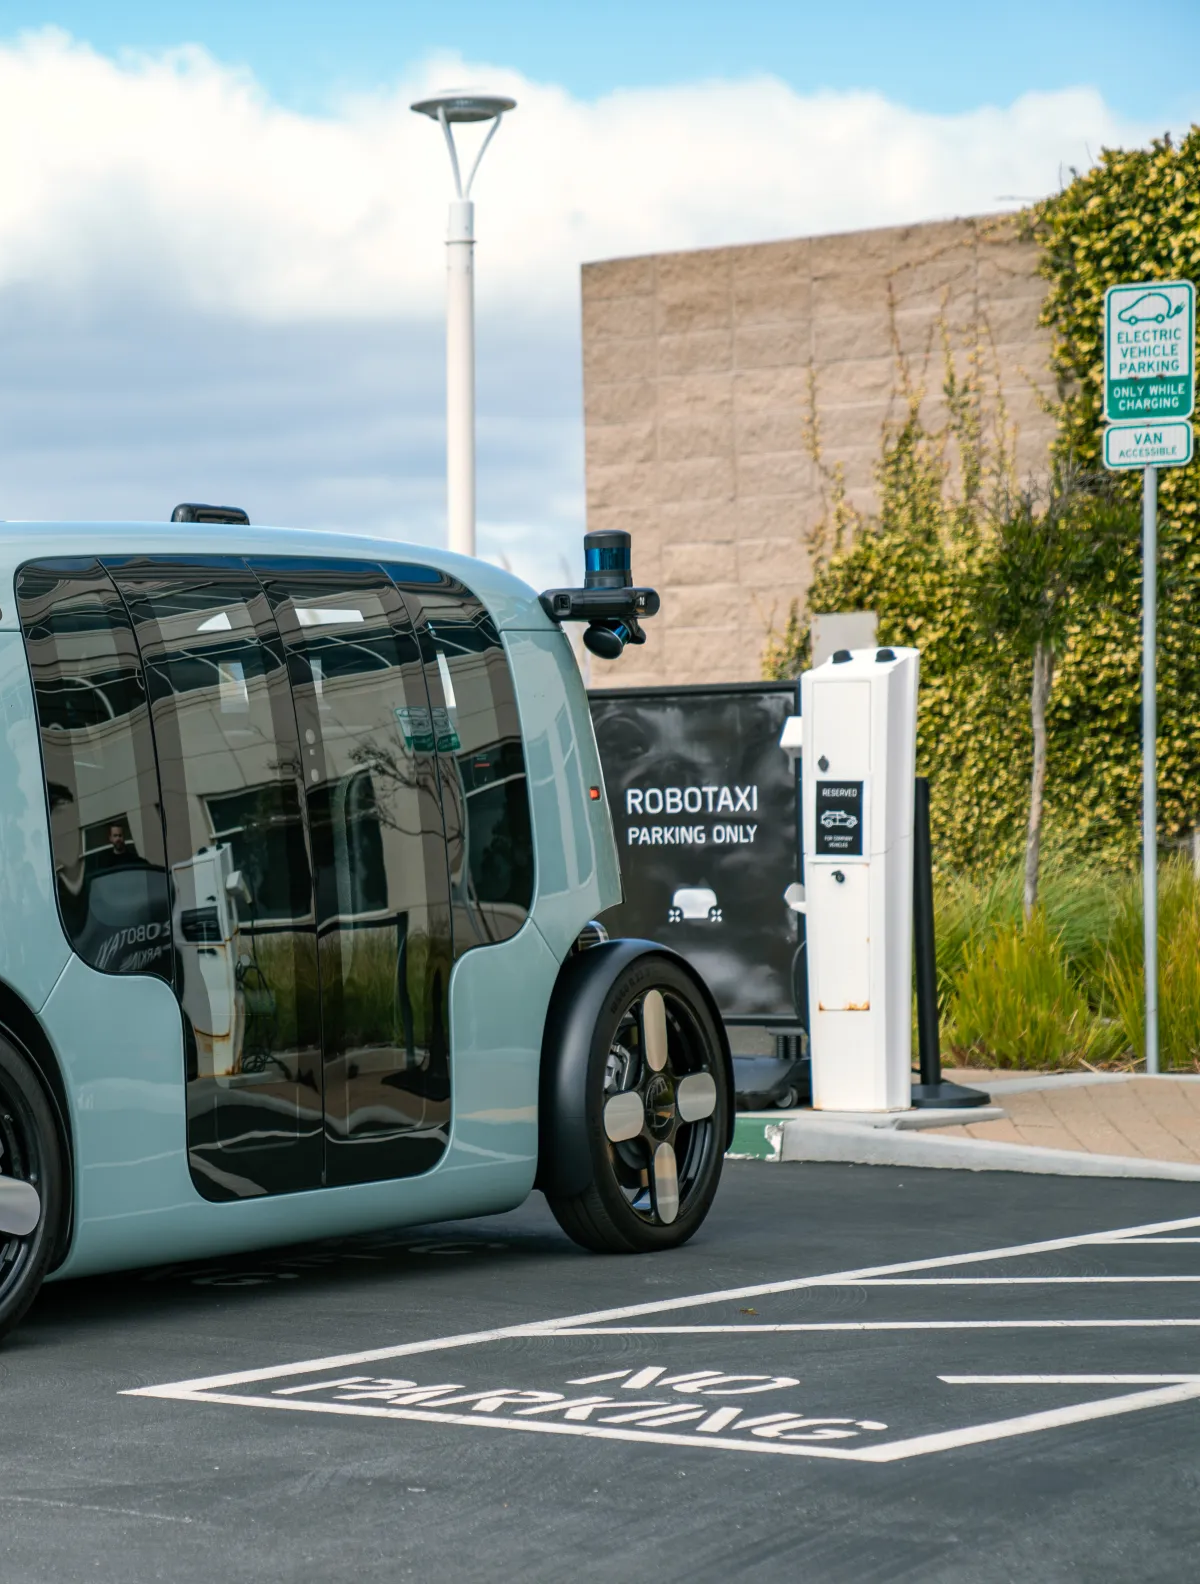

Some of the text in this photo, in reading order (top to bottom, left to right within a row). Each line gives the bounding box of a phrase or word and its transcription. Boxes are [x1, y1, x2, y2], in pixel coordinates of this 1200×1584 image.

[1117, 328, 1181, 345] ELECTRIC
[1120, 343, 1179, 359] VEHICLE
[1119, 359, 1180, 375] PARKING
[1113, 383, 1185, 399] ONLY WHILE
[1118, 397, 1180, 411] CHARGING
[1134, 432, 1163, 446] VAN
[1118, 446, 1178, 459] ACCESSIBLE
[625, 785, 759, 815] ROBOTAXI
[821, 787, 858, 798] RESERVED
[627, 824, 758, 845] PARKING ONLY
[564, 1366, 800, 1395] NO
[271, 1376, 889, 1441] PARKING
